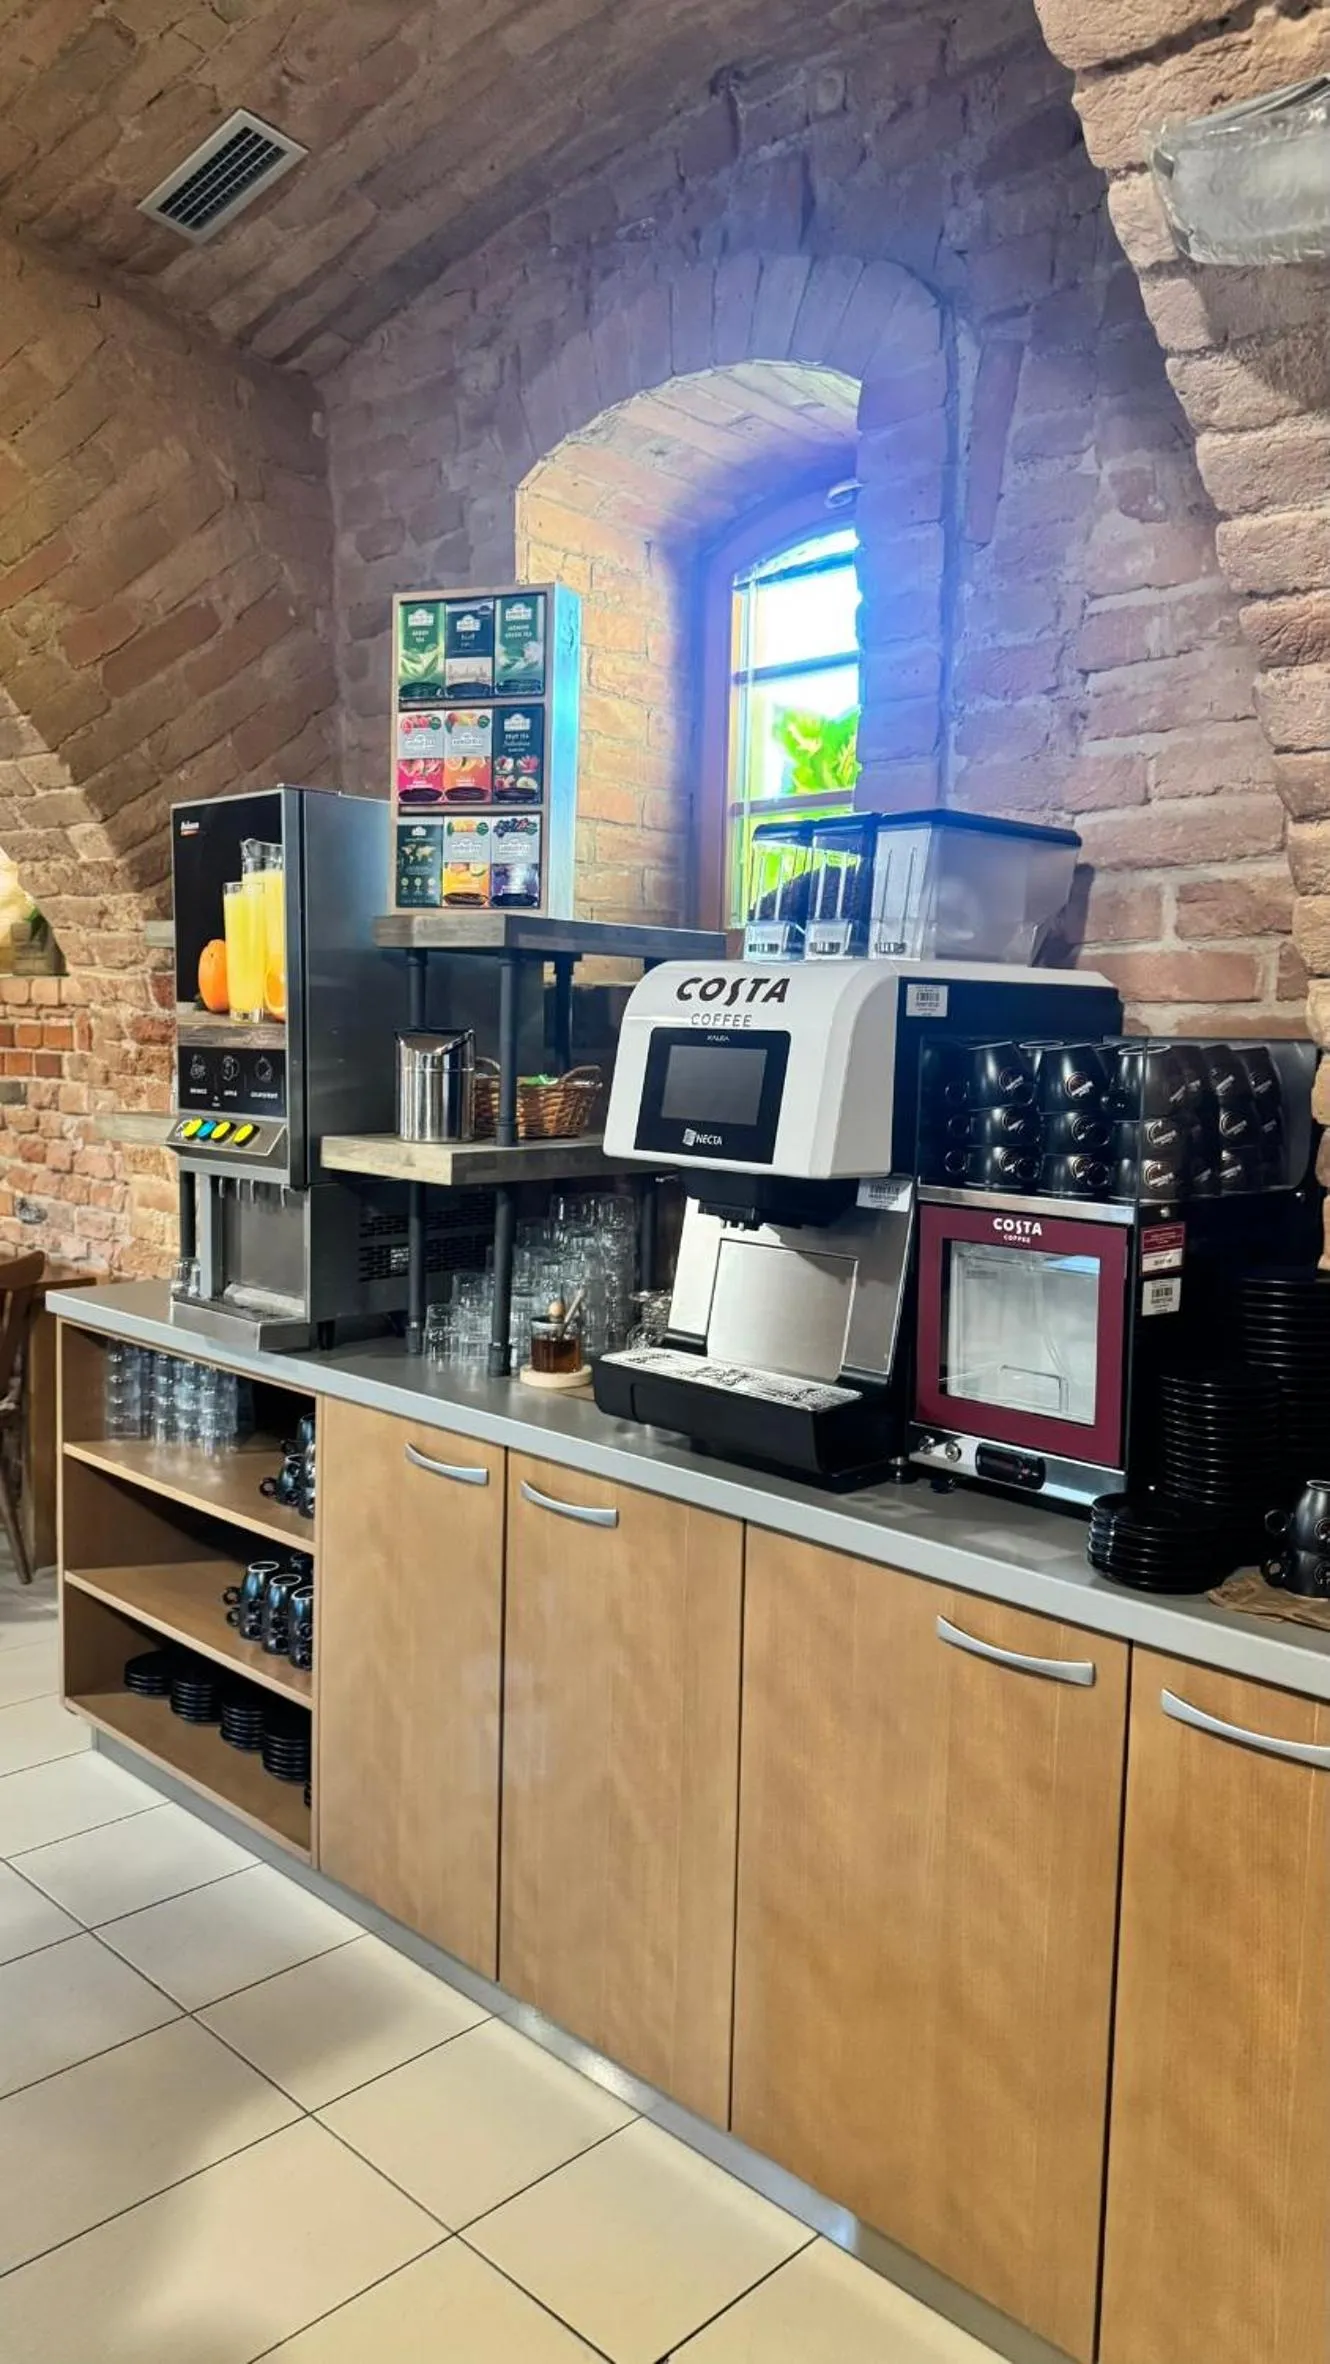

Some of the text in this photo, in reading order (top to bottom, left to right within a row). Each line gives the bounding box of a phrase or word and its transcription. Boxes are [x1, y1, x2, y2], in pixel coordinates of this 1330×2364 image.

[676, 977, 790, 1007] COSTA
[691, 1013, 752, 1027] COFFEE
[696, 1134, 723, 1146] NECTA
[993, 1218, 1042, 1236] COSTA
[1003, 1234, 1031, 1243] COFFEE
